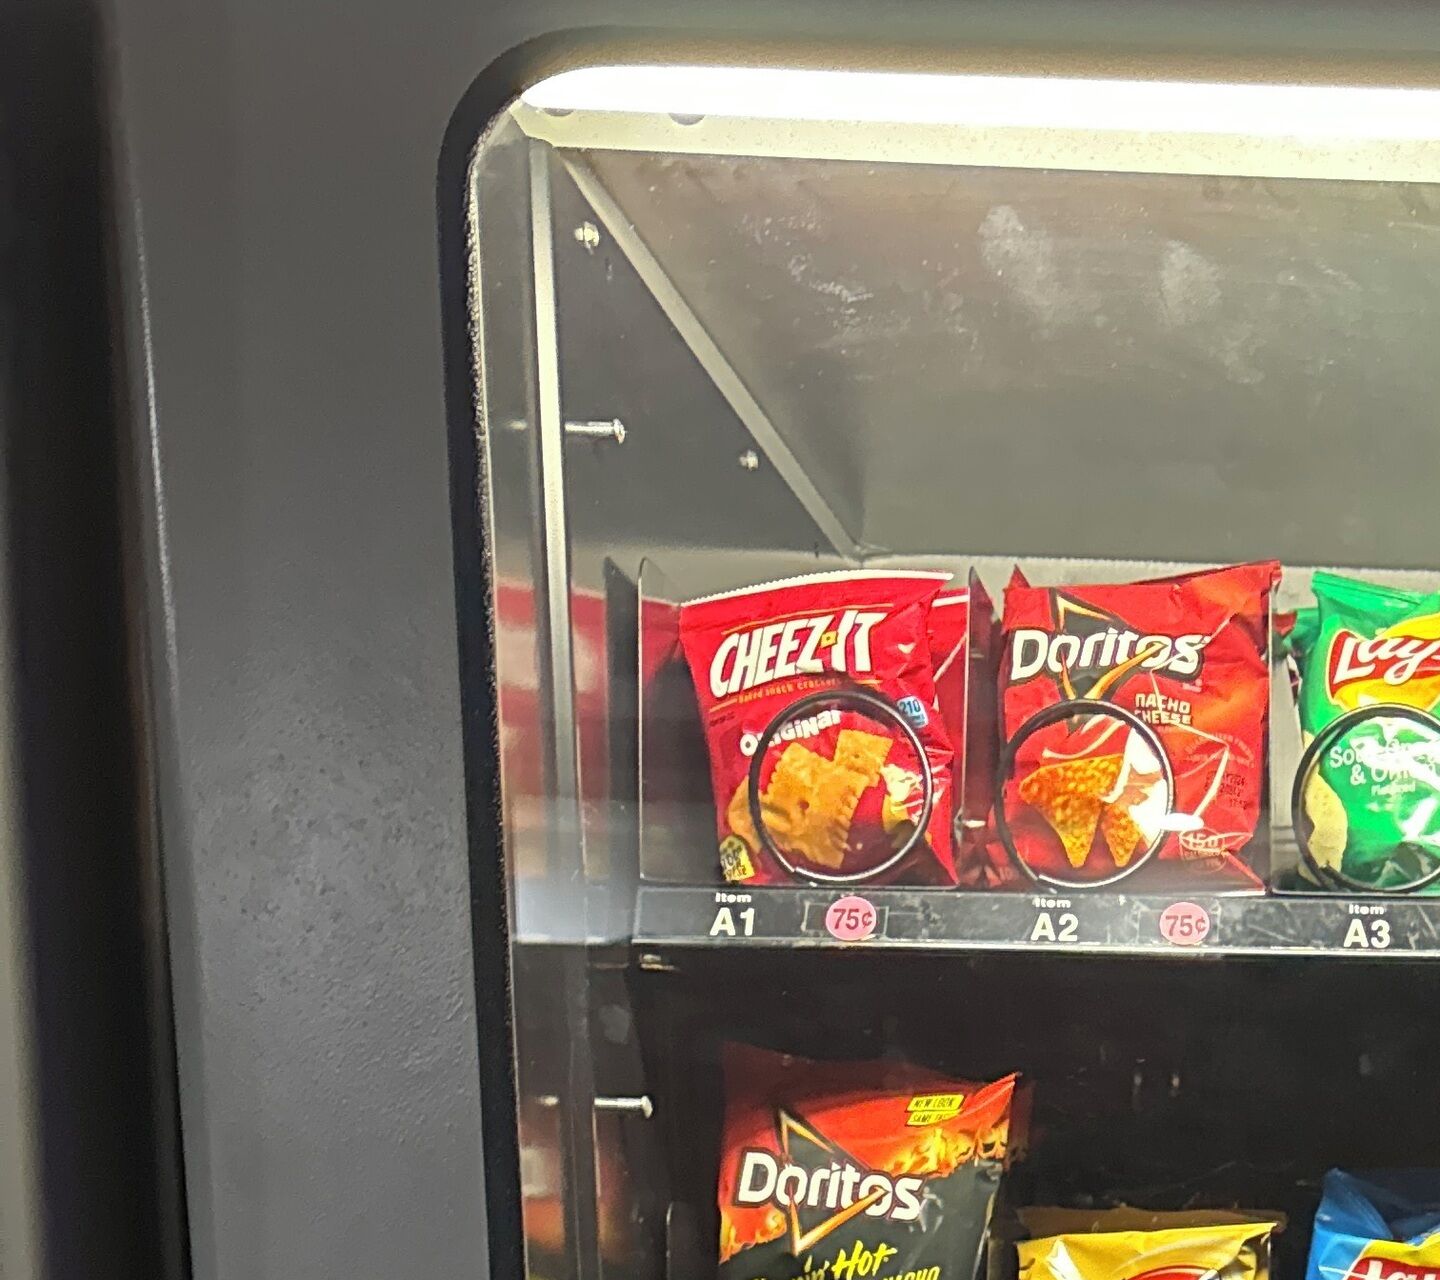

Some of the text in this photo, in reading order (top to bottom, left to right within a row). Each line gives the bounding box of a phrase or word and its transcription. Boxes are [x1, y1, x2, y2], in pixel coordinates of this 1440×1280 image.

[1010, 629, 1207, 681] Doritos
[1134, 692, 1192, 714] NACHO
[1350, 764, 1366, 785] &
[715, 891, 752, 904] Item
[1033, 897, 1071, 909] Item
[1348, 903, 1385, 915] Item
[709, 906, 755, 938] A1
[833, 907, 873, 931] 75¢
[1030, 912, 1079, 942] A2
[1165, 913, 1207, 936] 75¢
[1343, 918, 1391, 949] A3
[735, 1151, 923, 1221] Doritos
